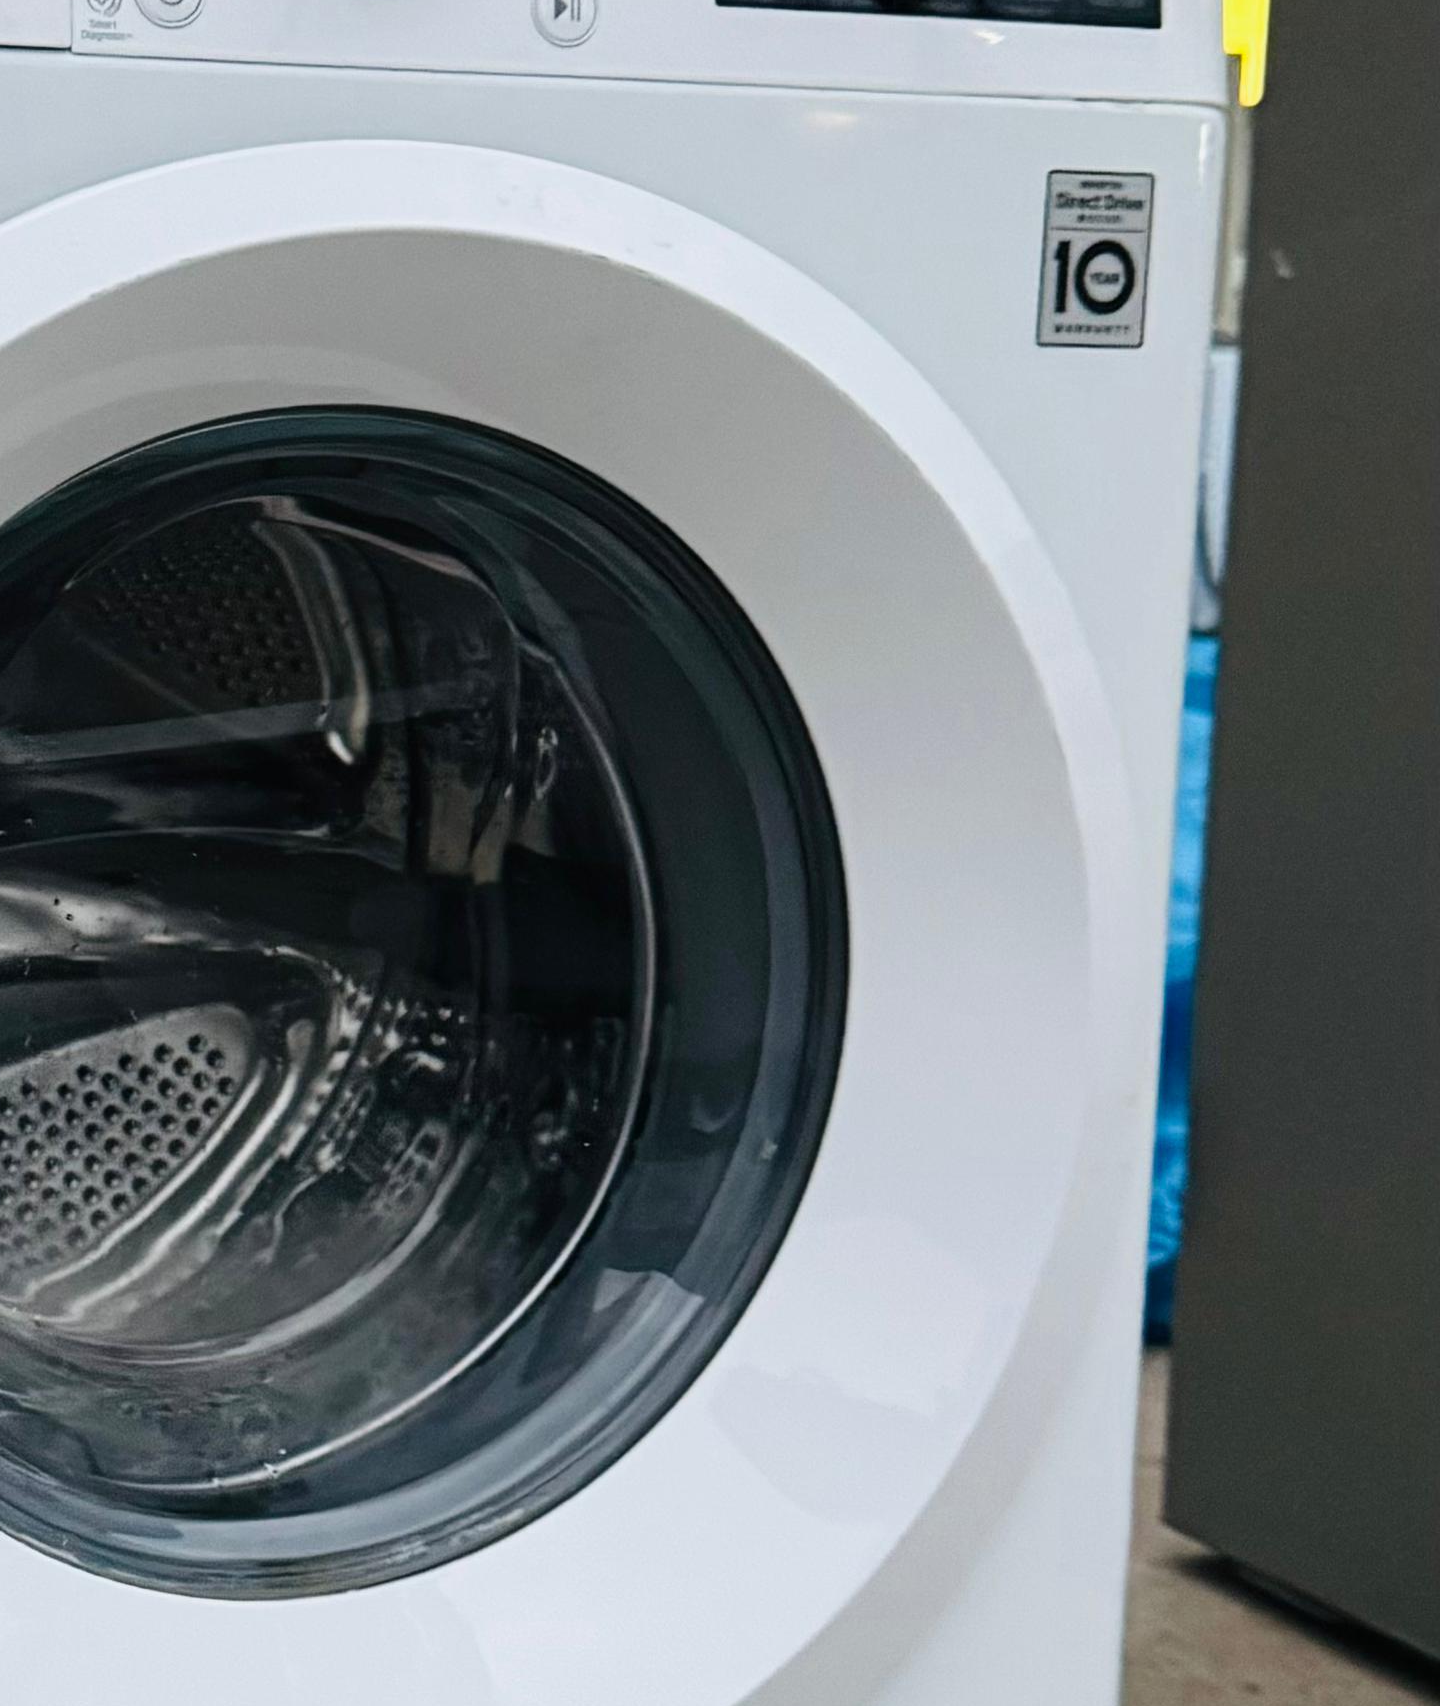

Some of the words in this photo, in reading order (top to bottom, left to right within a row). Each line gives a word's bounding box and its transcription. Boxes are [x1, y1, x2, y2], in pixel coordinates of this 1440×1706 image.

[1056, 192, 1102, 211] Direct
[1054, 240, 1135, 315] 10
[1090, 272, 1120, 285] YEAR
